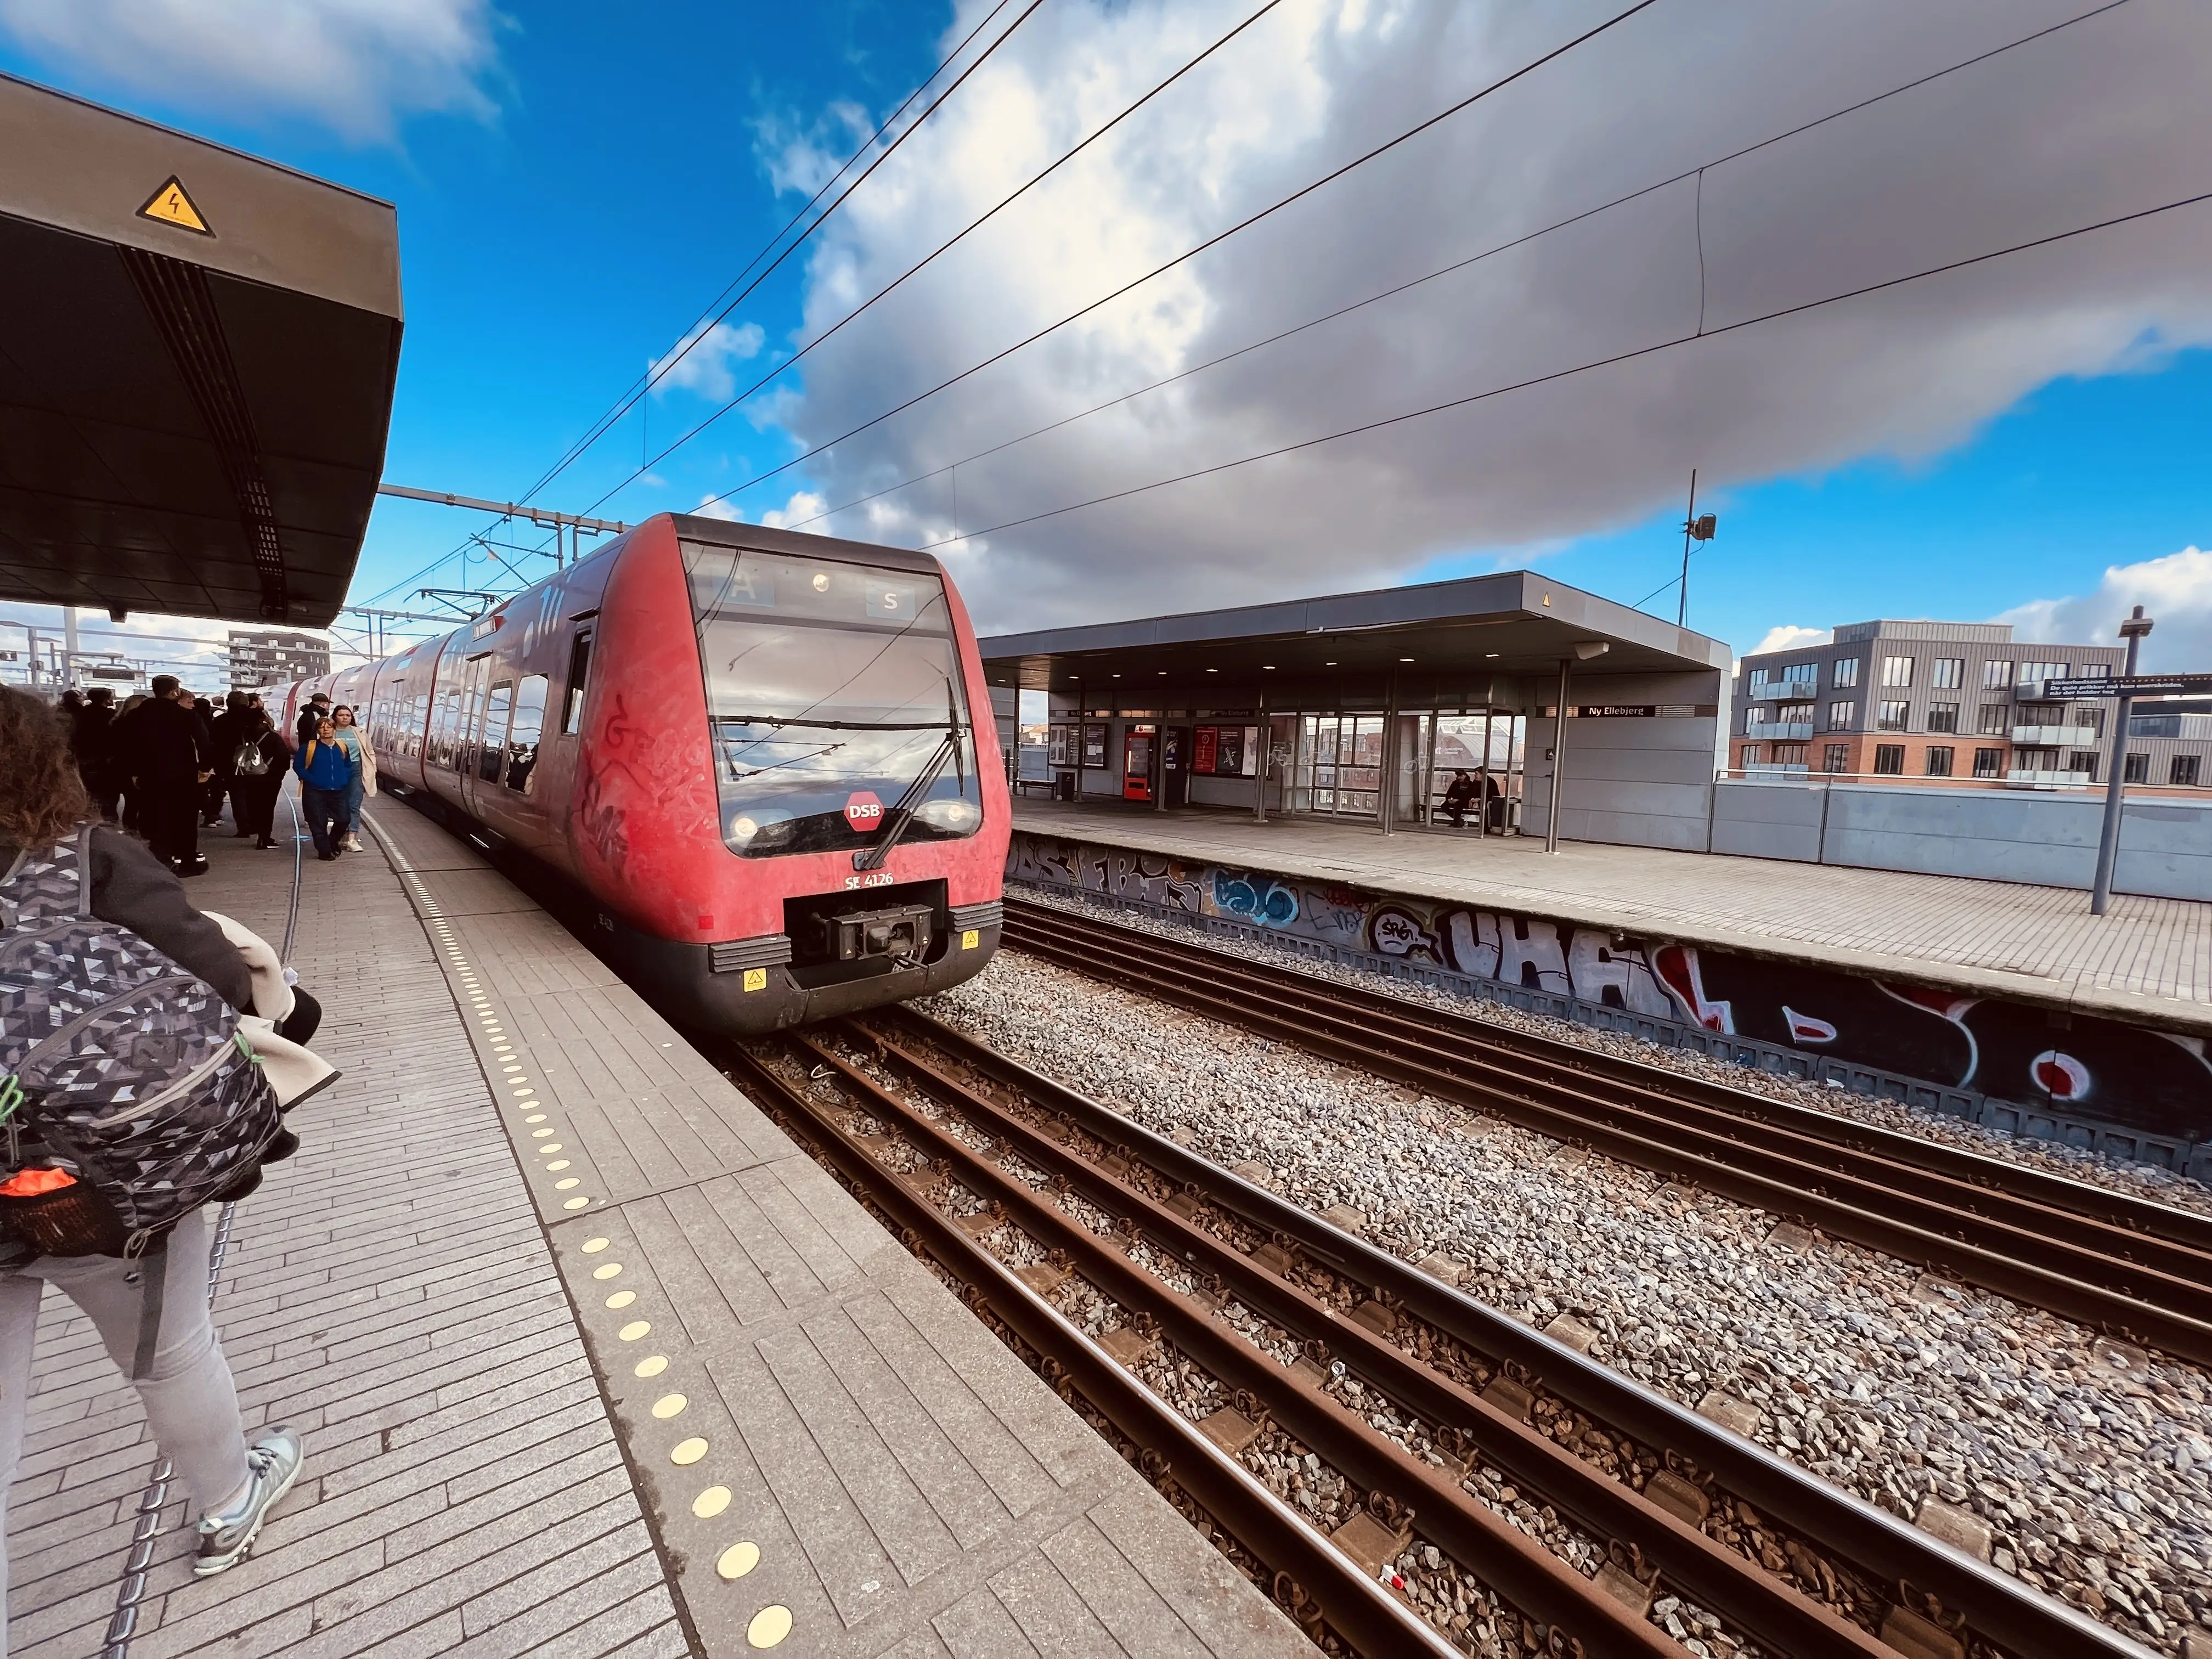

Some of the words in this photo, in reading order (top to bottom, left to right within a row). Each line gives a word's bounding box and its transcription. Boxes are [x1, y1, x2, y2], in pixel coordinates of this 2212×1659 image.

[730, 571, 757, 600] A
[883, 592, 898, 610] S
[1589, 707, 1602, 716] Ny
[1604, 707, 1644, 716] Ellebjerg
[849, 804, 881, 819] DSB
[845, 876, 861, 890] SE
[864, 872, 894, 887] 4126
